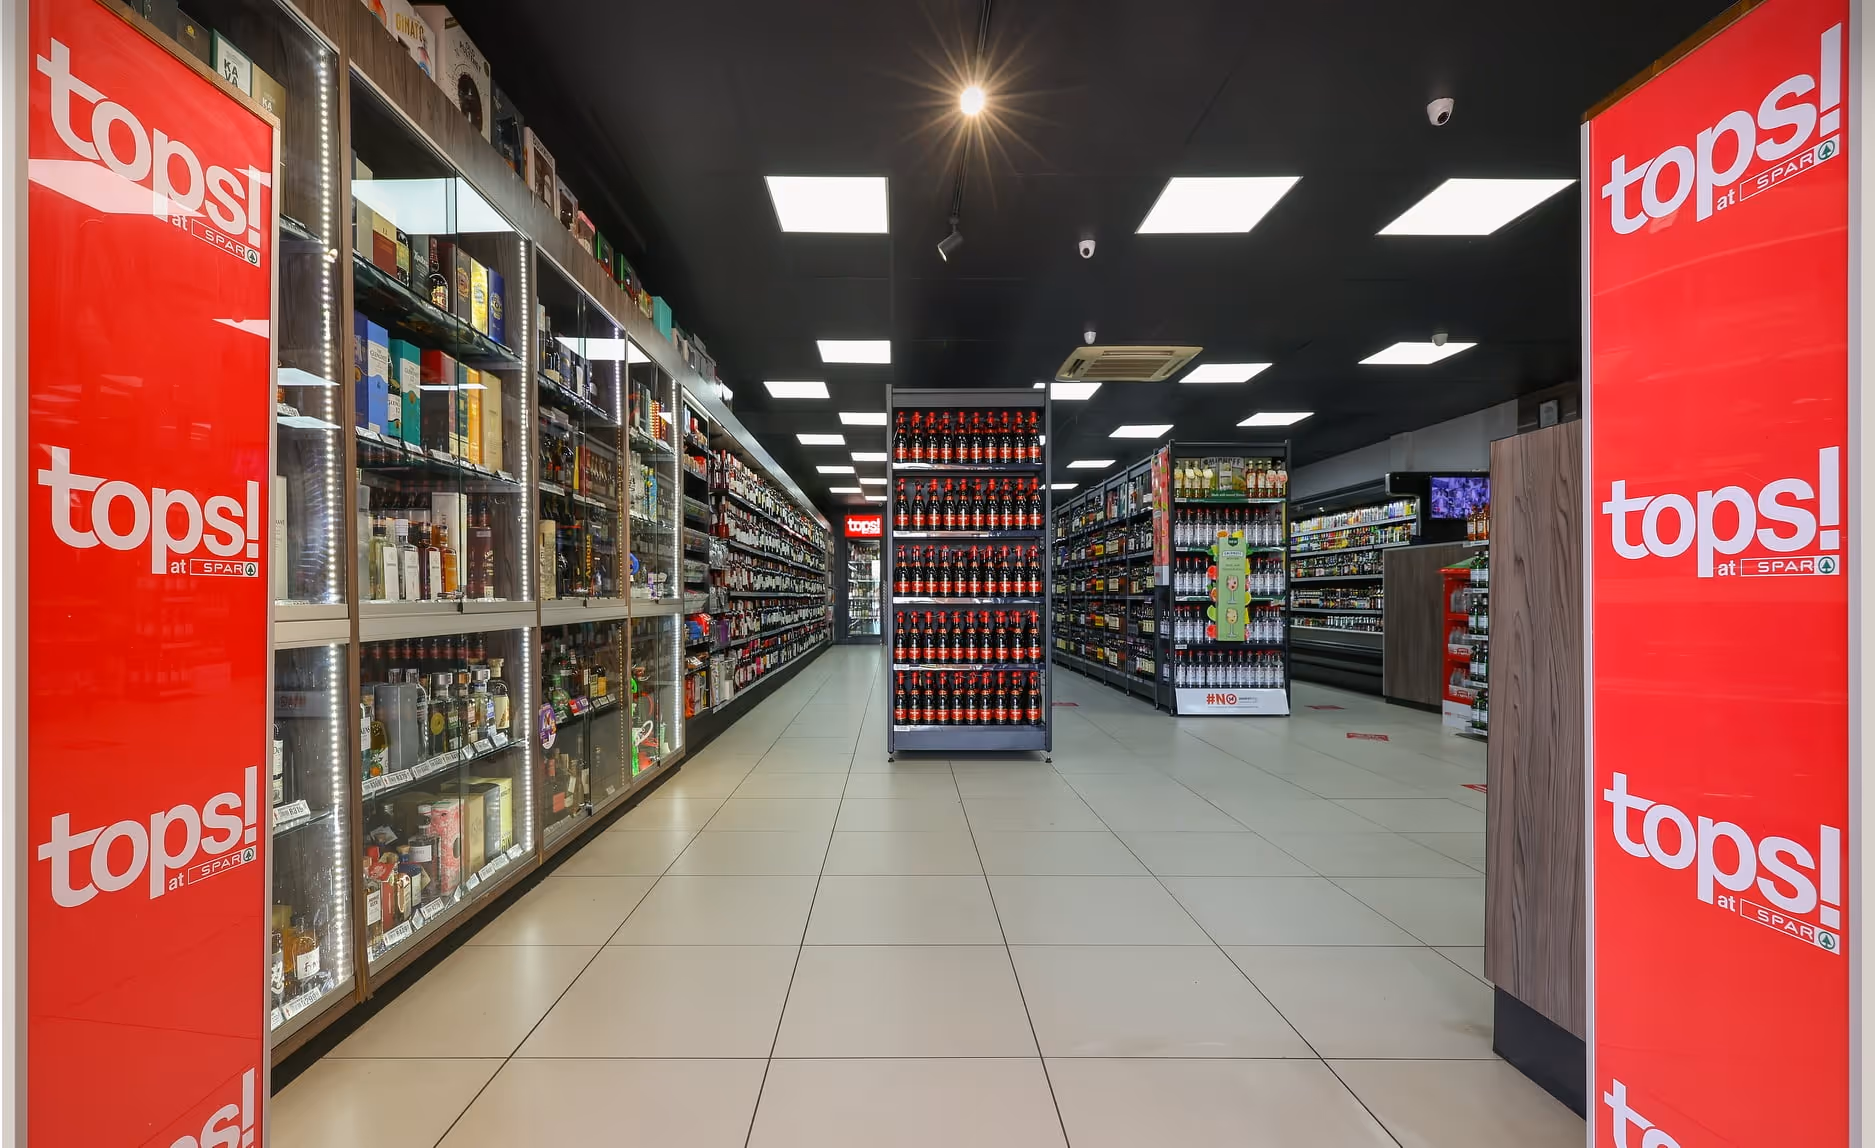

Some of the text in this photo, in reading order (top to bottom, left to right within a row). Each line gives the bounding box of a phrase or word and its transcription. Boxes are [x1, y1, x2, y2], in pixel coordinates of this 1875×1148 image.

[224, 58, 239, 79] KA
[36, 37, 262, 249] tops!
[1601, 22, 1842, 235] tops!
[1717, 152, 1814, 211] at SPAR
[171, 214, 245, 257] at SPAR
[37, 446, 260, 574] tops!
[847, 517, 881, 535] tops!
[1602, 446, 1840, 578] tops!
[170, 559, 243, 574] at SPAR
[1717, 559, 1814, 577] at SPAR
[36, 766, 258, 908] tops!
[1603, 772, 1841, 932] tops!
[168, 854, 241, 891] at SPAR
[1717, 895, 1814, 940] at SPAR
